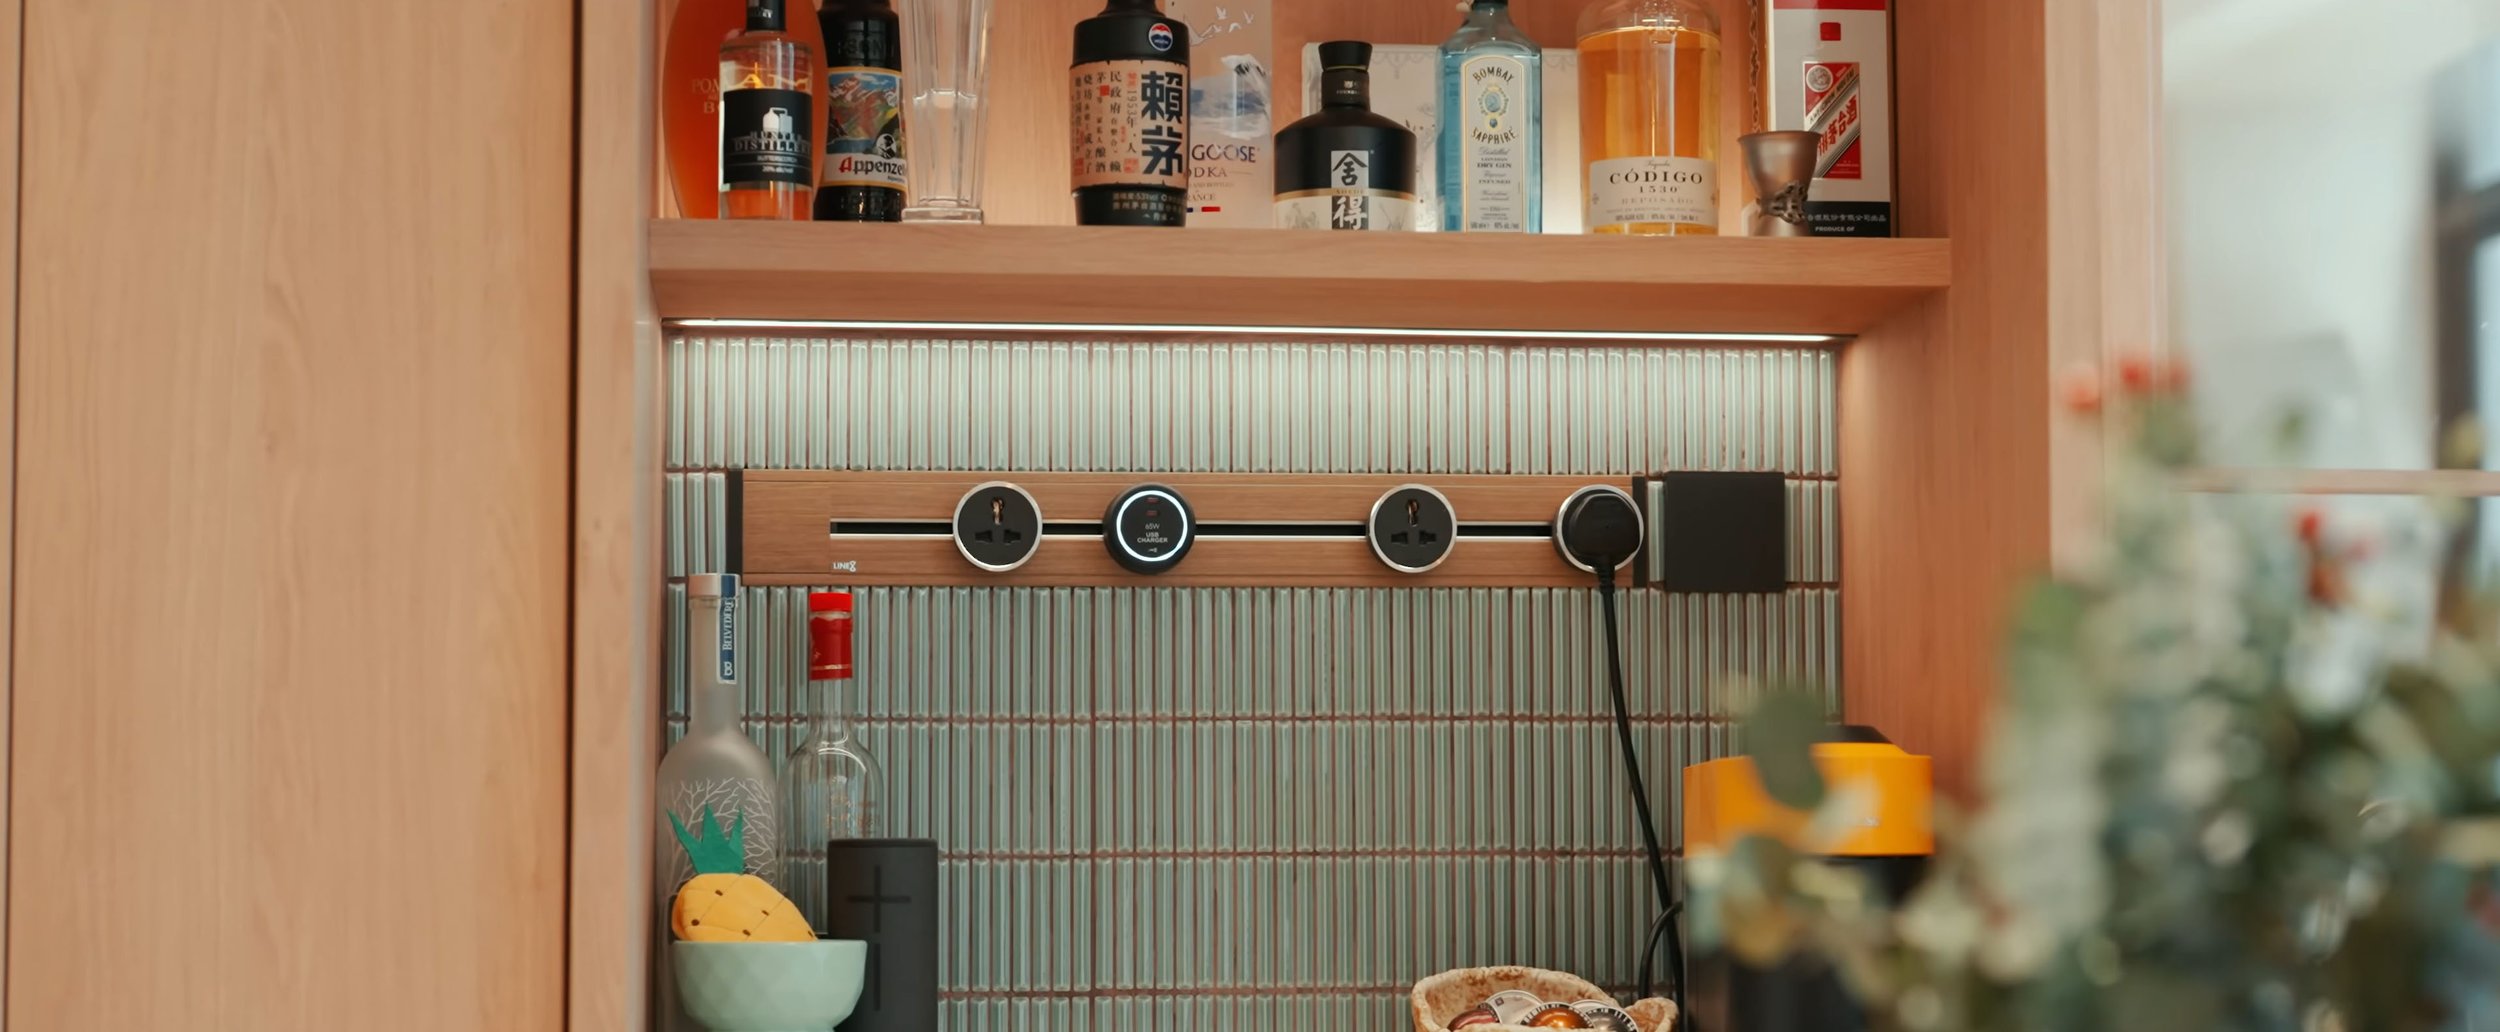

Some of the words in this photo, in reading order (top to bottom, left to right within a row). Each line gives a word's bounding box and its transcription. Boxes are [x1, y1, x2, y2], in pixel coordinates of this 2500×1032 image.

[1472, 66, 1514, 83] BOMBAY
[1818, 94, 1857, 157] 州茅台酒
[1472, 127, 1516, 144] SAPPHIRE
[1191, 143, 1256, 163] GOOSE
[1185, 166, 1228, 178] ODKA
[1609, 168, 1703, 185] CÓDIGO
[1333, 152, 1367, 231] 舍得
[1640, 185, 1678, 194] 1530
[722, 599, 734, 651] BELVEDERE
